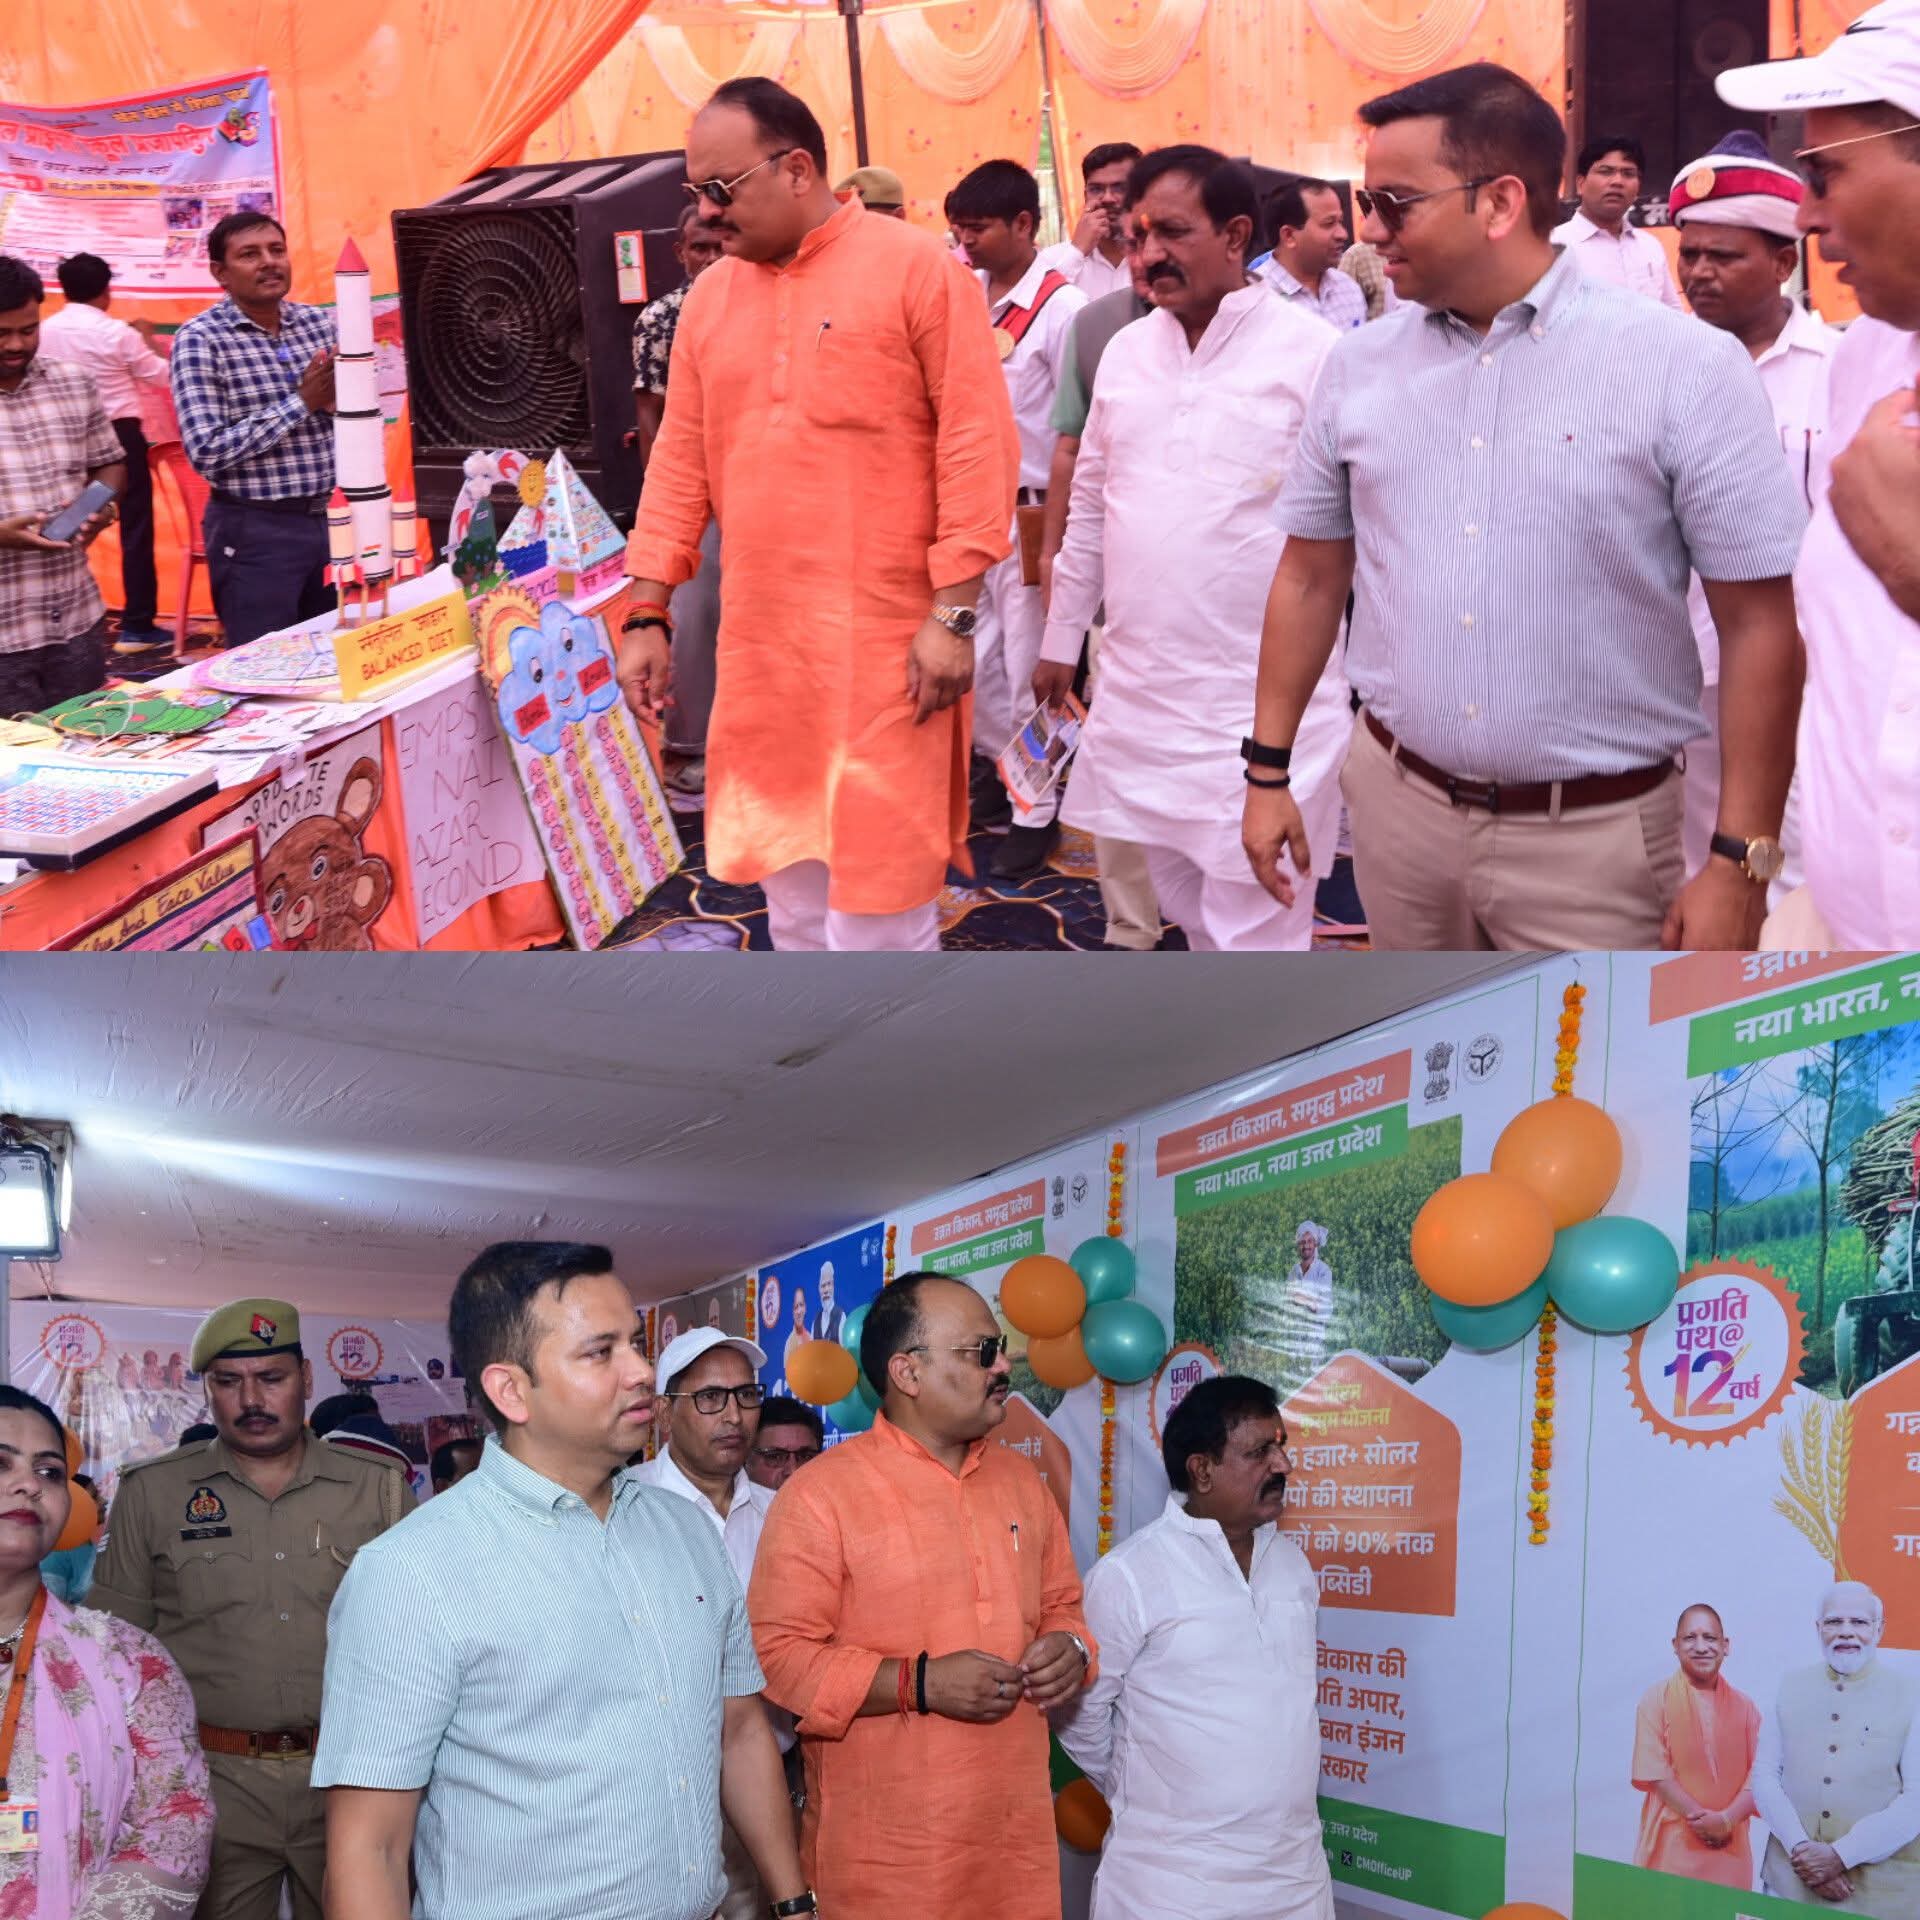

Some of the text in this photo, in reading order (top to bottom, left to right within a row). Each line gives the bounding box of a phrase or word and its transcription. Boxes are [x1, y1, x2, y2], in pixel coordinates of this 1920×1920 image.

[361, 628, 456, 681] BALANCED DIET
[244, 760, 331, 830] OPPOTE
[260, 786, 325, 839] WORDS
[1734, 1006, 1795, 1043] नया
[1801, 981, 1890, 1027] भारत,
[1197, 1073, 1386, 1155] उन्नत किसान, समृद्ध प्रदेश
[1195, 1123, 1383, 1197] नया भारत, नया उत्तर प्रदेश
[1676, 1287, 1750, 1327] प्रगति
[340, 1352, 363, 1371] 12
[1170, 1360, 1203, 1385] प्रगति
[1663, 1349, 1761, 1417] 12 वर्ष
[1341, 1404, 1391, 1427] योजना
[1363, 1435, 1420, 1465] सोलर
[1311, 1479, 1338, 1508] की
[1341, 1485, 1414, 1508] स्थापना
[1313, 1522, 1341, 1553] को
[1344, 1531, 1391, 1554] 90%
[1394, 1532, 1436, 1555] तक
[1314, 1564, 1372, 1596] ब्सिडी
[1376, 1647, 1407, 1679] की
[1316, 1677, 1406, 1720] ति अपार,
[1319, 1718, 1406, 1755] बल इंजन
[1320, 1754, 1368, 1785] रकार
[1356, 1855, 1413, 1881] CMOfficeUP
